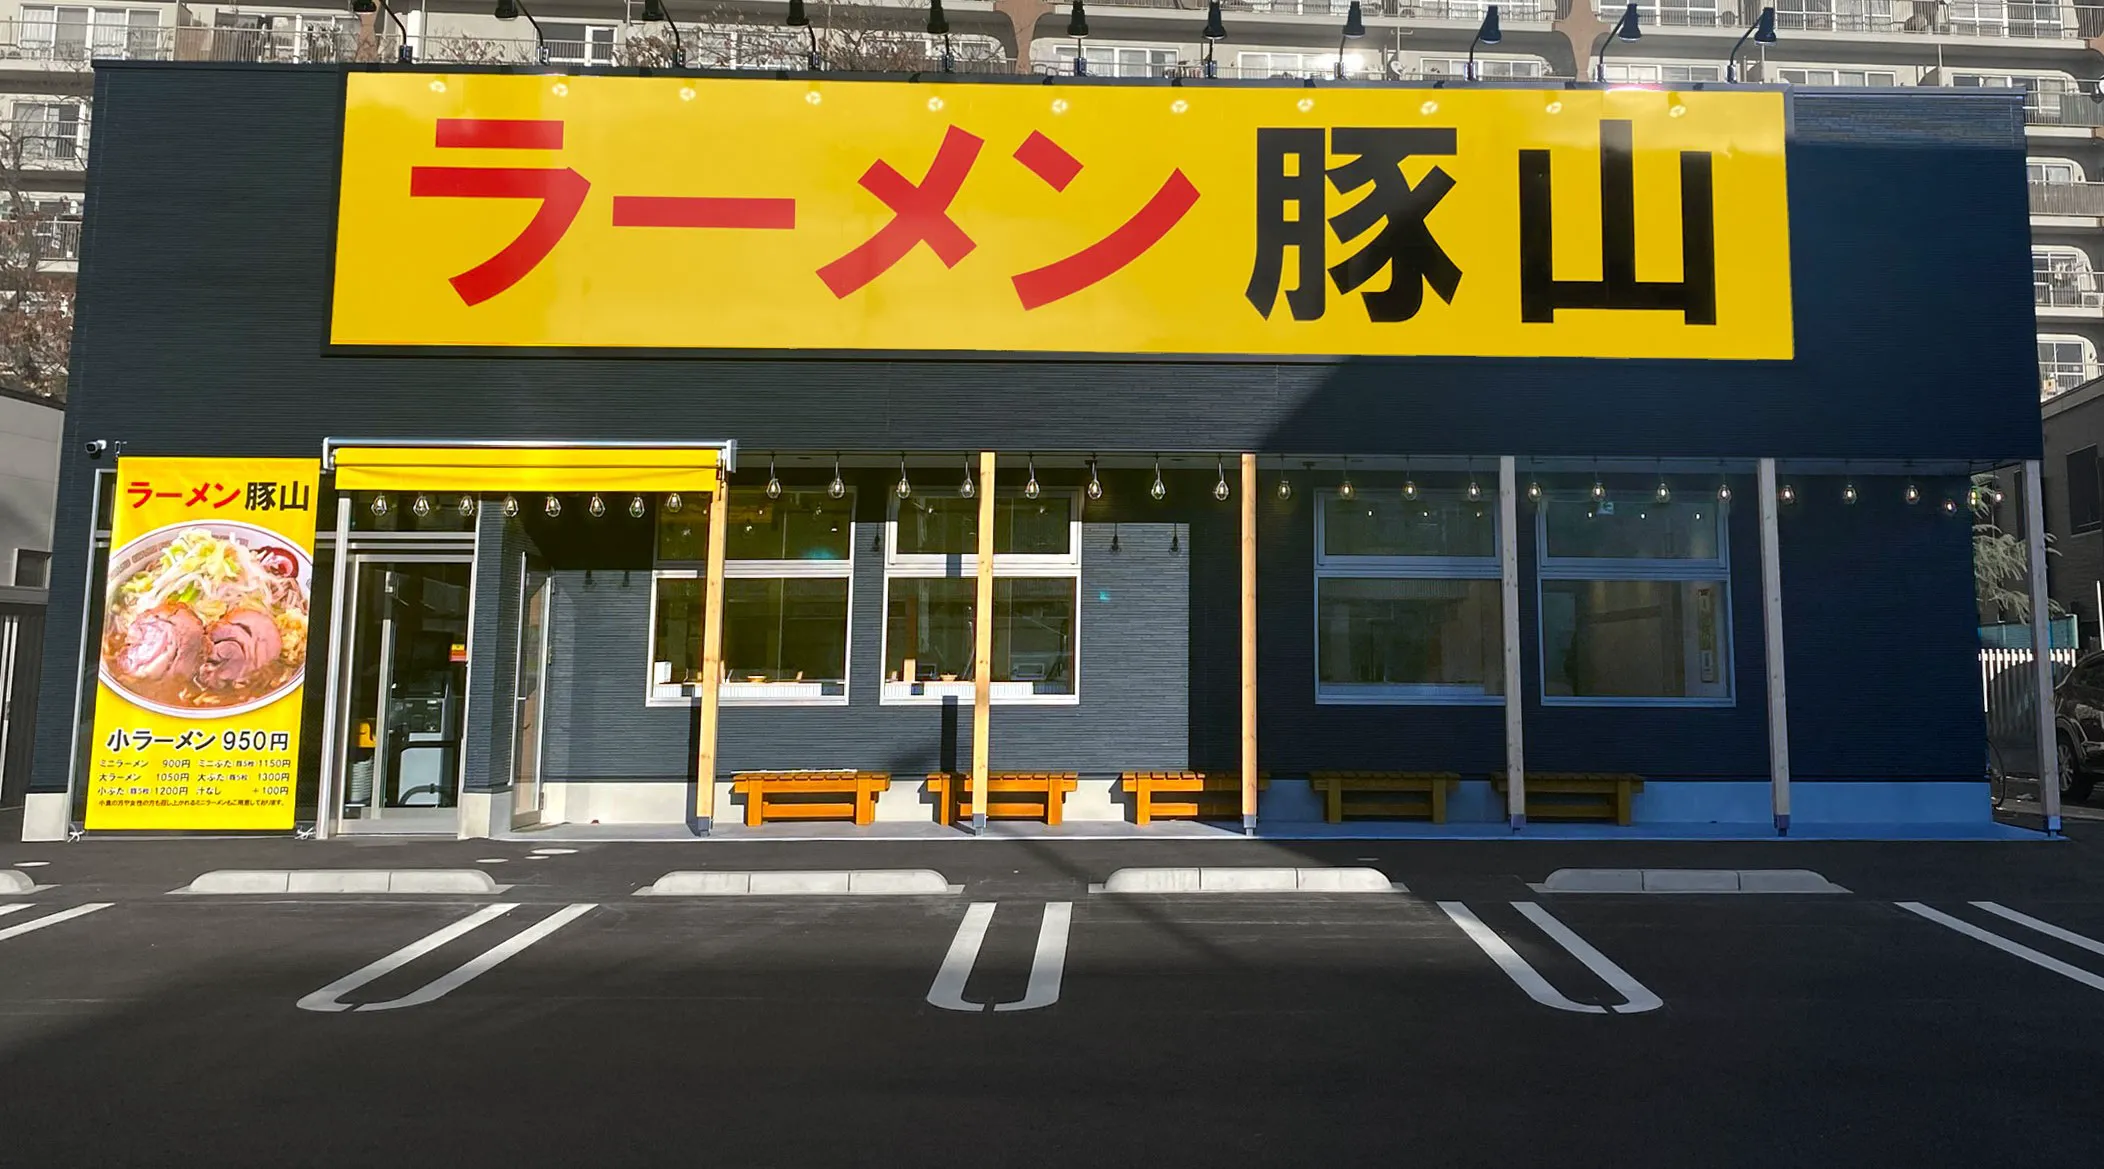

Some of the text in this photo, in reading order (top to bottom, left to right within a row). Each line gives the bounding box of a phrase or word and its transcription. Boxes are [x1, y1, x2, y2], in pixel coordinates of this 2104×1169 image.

[107, 729, 289, 752] 小ラーメン 950円
[99, 759, 191, 768] ミニラーメン 900円
[259, 759, 291, 768] 1150円
[98, 773, 190, 782] 大ラーメン 1050円
[258, 773, 290, 782] 1300円
[155, 787, 189, 796] 1200円
[196, 786, 221, 795] 汁なし
